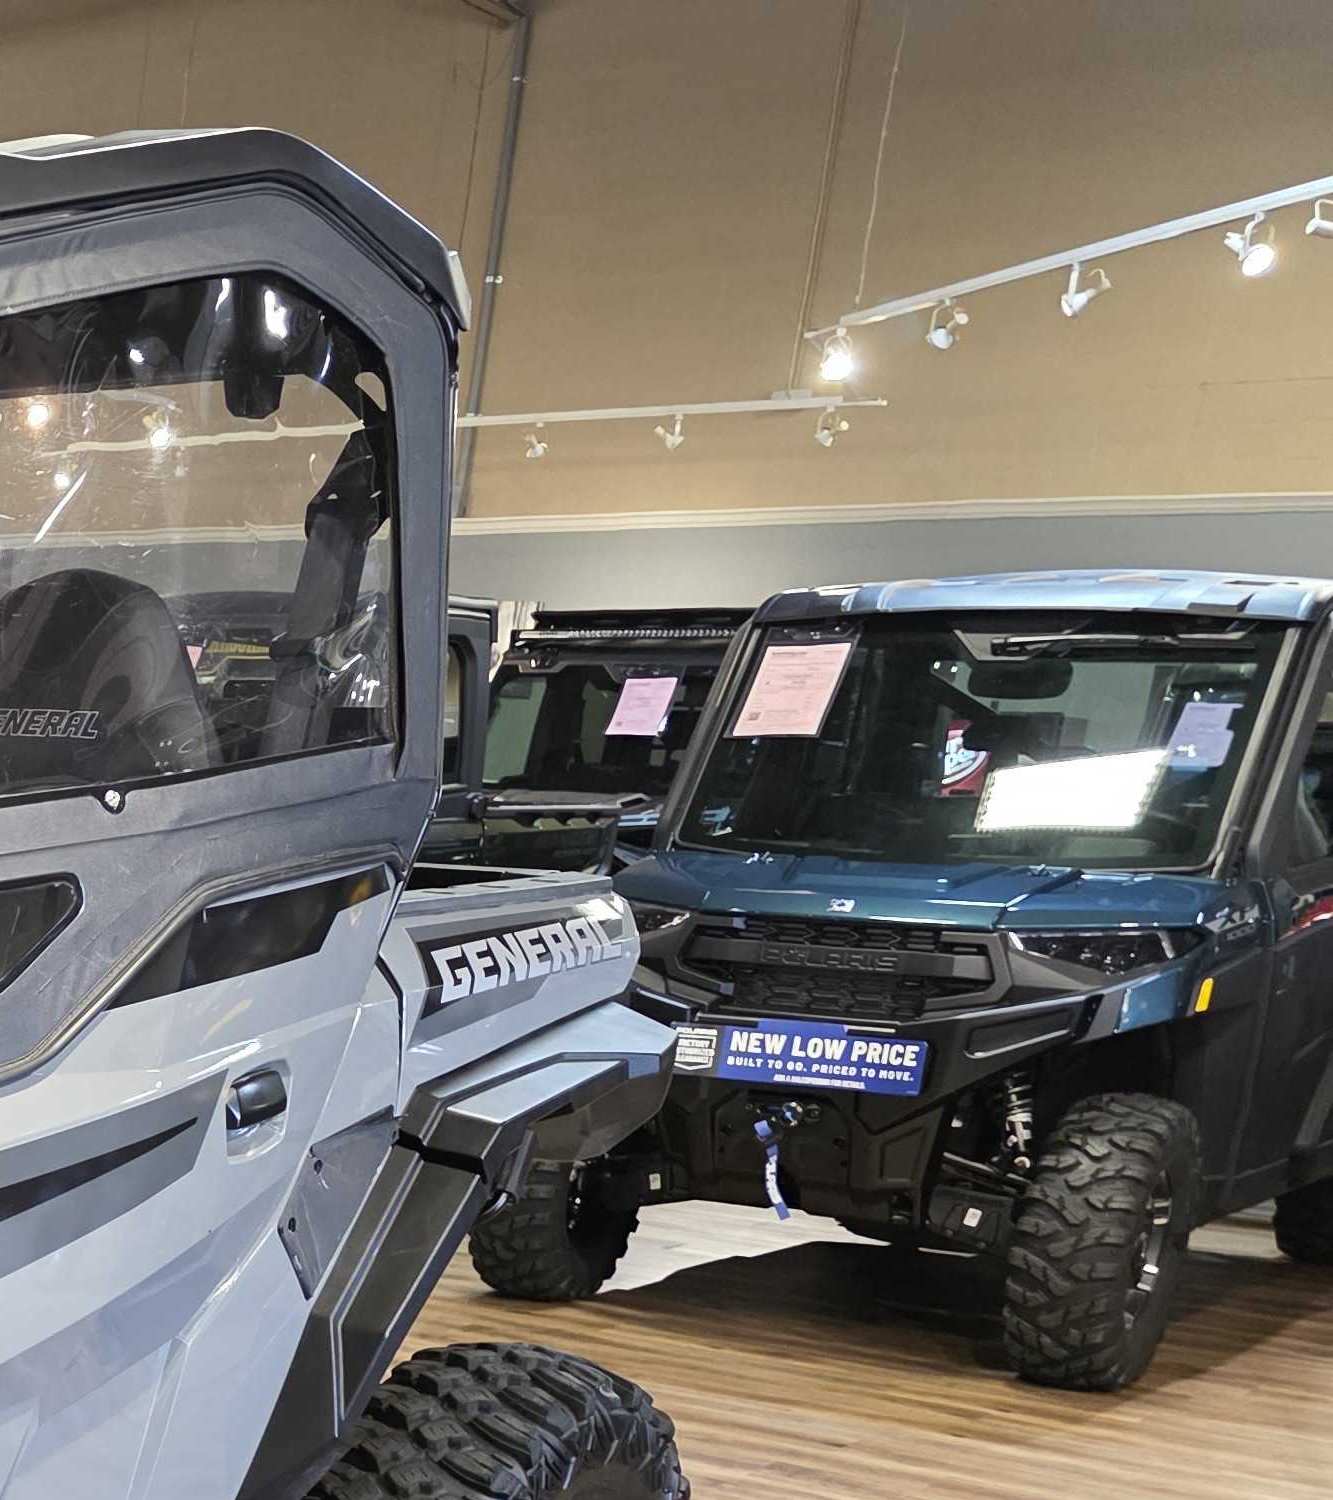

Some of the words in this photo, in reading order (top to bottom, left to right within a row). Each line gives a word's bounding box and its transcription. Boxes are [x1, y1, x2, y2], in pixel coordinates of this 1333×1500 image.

[429, 916, 622, 1004] GENERAL
[762, 946, 898, 971] POLARIS
[729, 1030, 787, 1055] NEW
[791, 1035, 848, 1061] LOW
[850, 1040, 920, 1067] PRICE
[726, 1055, 764, 1068] BUILT
[767, 1059, 784, 1070] TO
[786, 1061, 807, 1073] GO.
[811, 1063, 857, 1077] PRICED
[860, 1067, 876, 1078] TO
[878, 1069, 915, 1082] MOVE.
